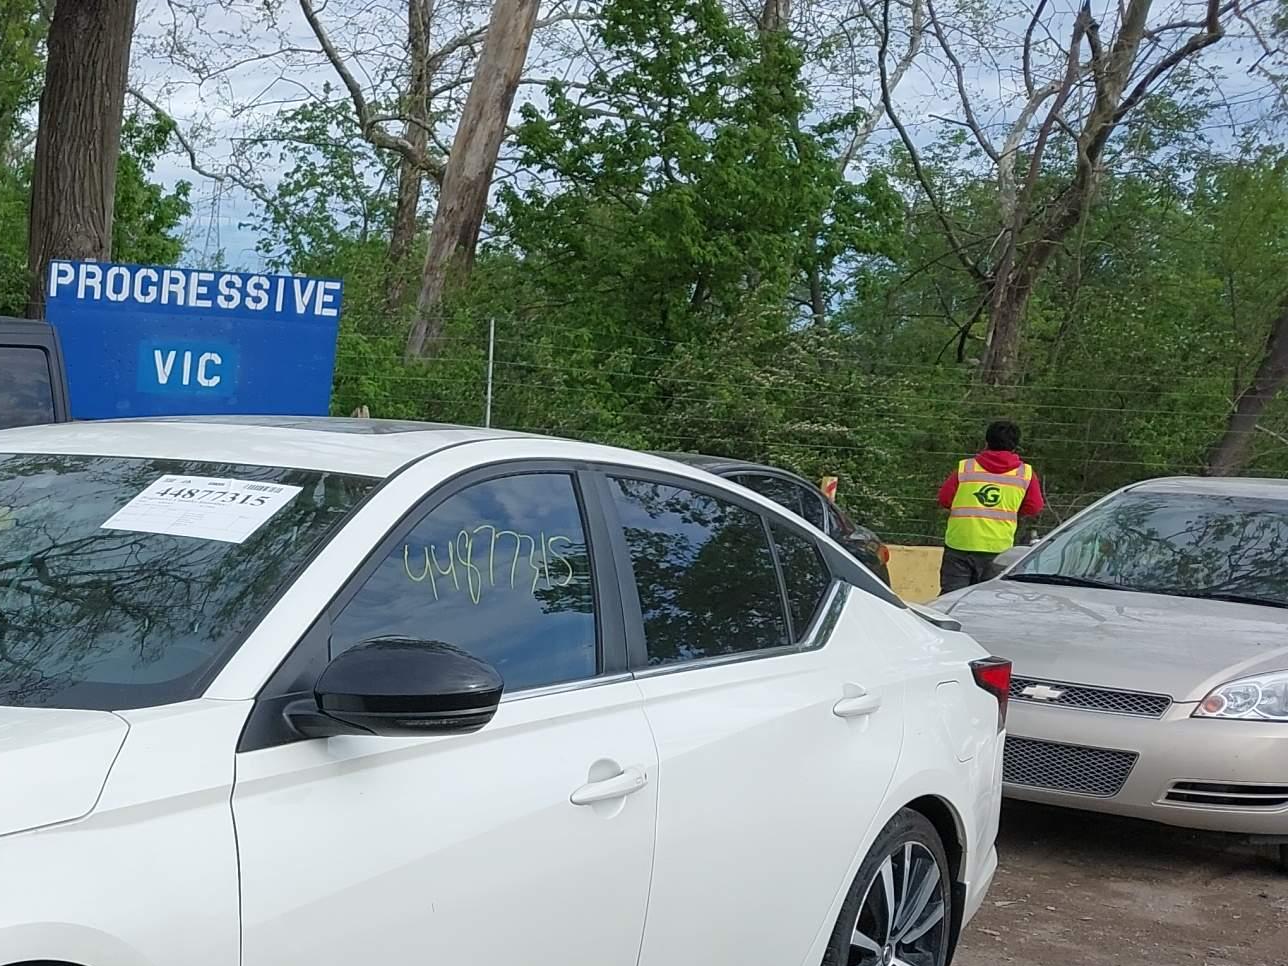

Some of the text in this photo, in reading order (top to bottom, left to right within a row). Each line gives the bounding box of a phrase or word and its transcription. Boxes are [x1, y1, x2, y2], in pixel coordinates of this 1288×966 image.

[49, 262, 341, 317] PROGRESSIVE
[154, 350, 223, 387] VIC
[155, 486, 272, 507] 44877315
